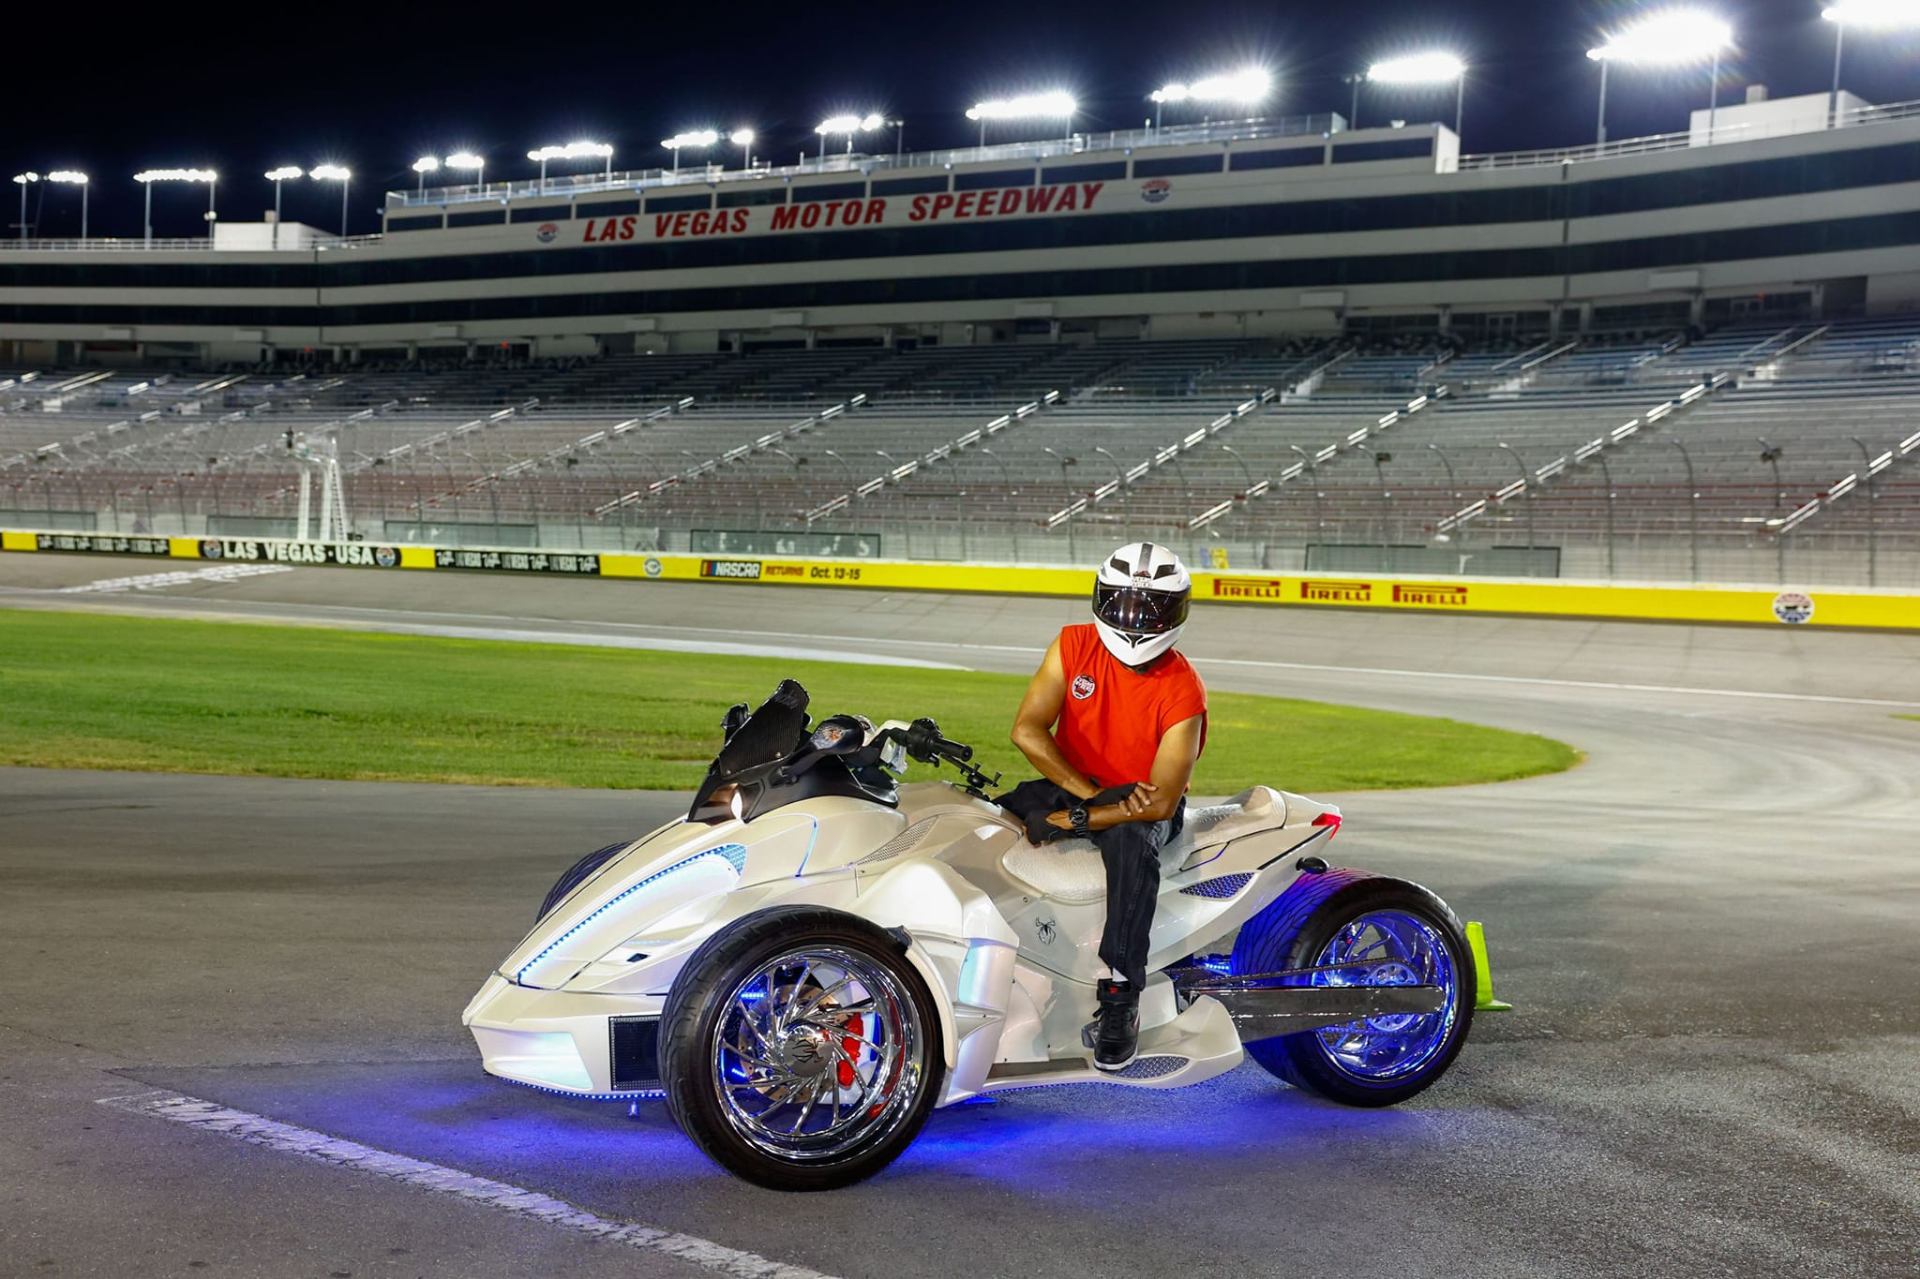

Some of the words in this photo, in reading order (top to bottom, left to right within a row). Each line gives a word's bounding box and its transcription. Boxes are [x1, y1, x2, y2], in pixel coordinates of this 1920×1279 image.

[583, 216, 637, 243] LAS
[655, 207, 750, 238] VEGAS
[770, 198, 887, 231] MOTOR
[908, 183, 1104, 222] SPEEDWAY
[223, 541, 258, 559] LAS
[715, 562, 761, 578] NASCAR
[765, 565, 804, 577] RETURNS
[811, 566, 832, 579] Oct.
[834, 567, 861, 580] 13-15
[1213, 578, 1281, 598] PIRELLI
[1301, 581, 1372, 602] PIRELLI
[1392, 584, 1468, 606] PIRELLI
